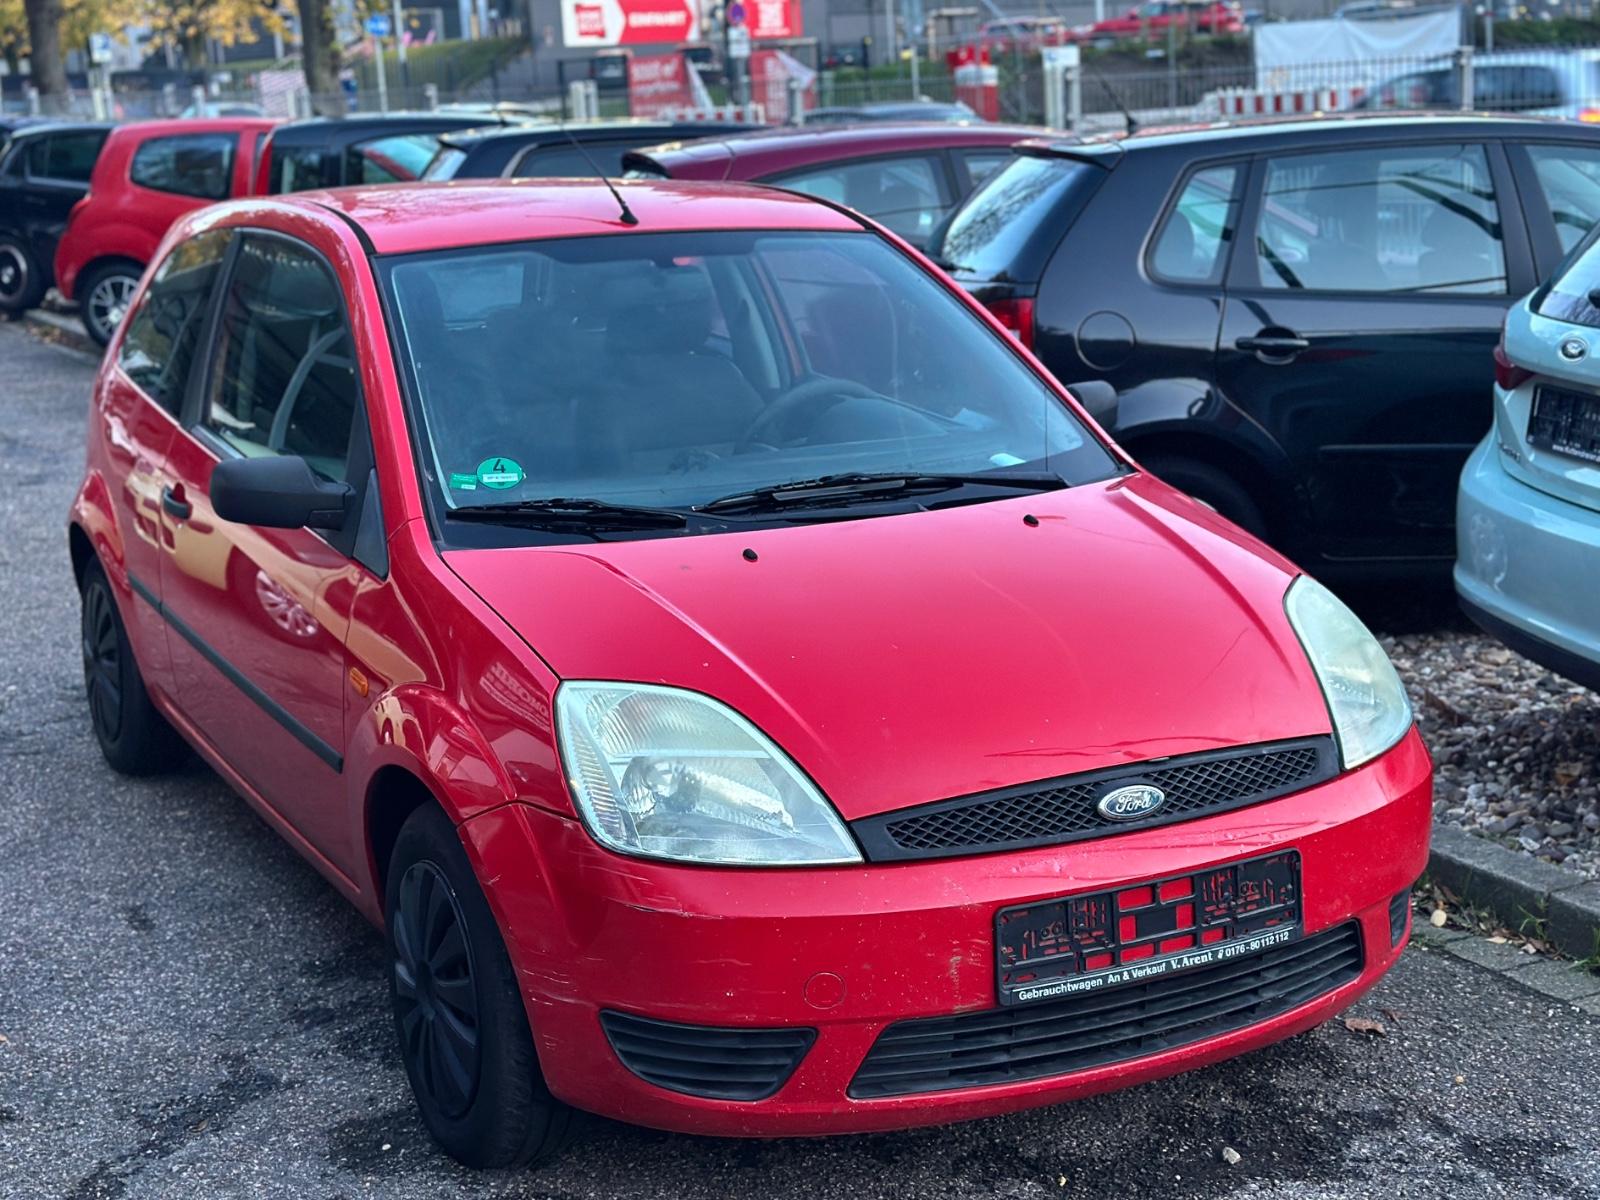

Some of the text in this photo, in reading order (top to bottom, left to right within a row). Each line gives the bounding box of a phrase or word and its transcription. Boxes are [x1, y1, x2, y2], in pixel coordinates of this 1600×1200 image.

[493, 458, 506, 473] 4
[1115, 790, 1152, 812] Ford
[1018, 977, 1103, 1001] Gebrauchtwagen
[1107, 974, 1121, 984] An
[1122, 972, 1130, 981] &
[1131, 963, 1166, 979] Verkauf
